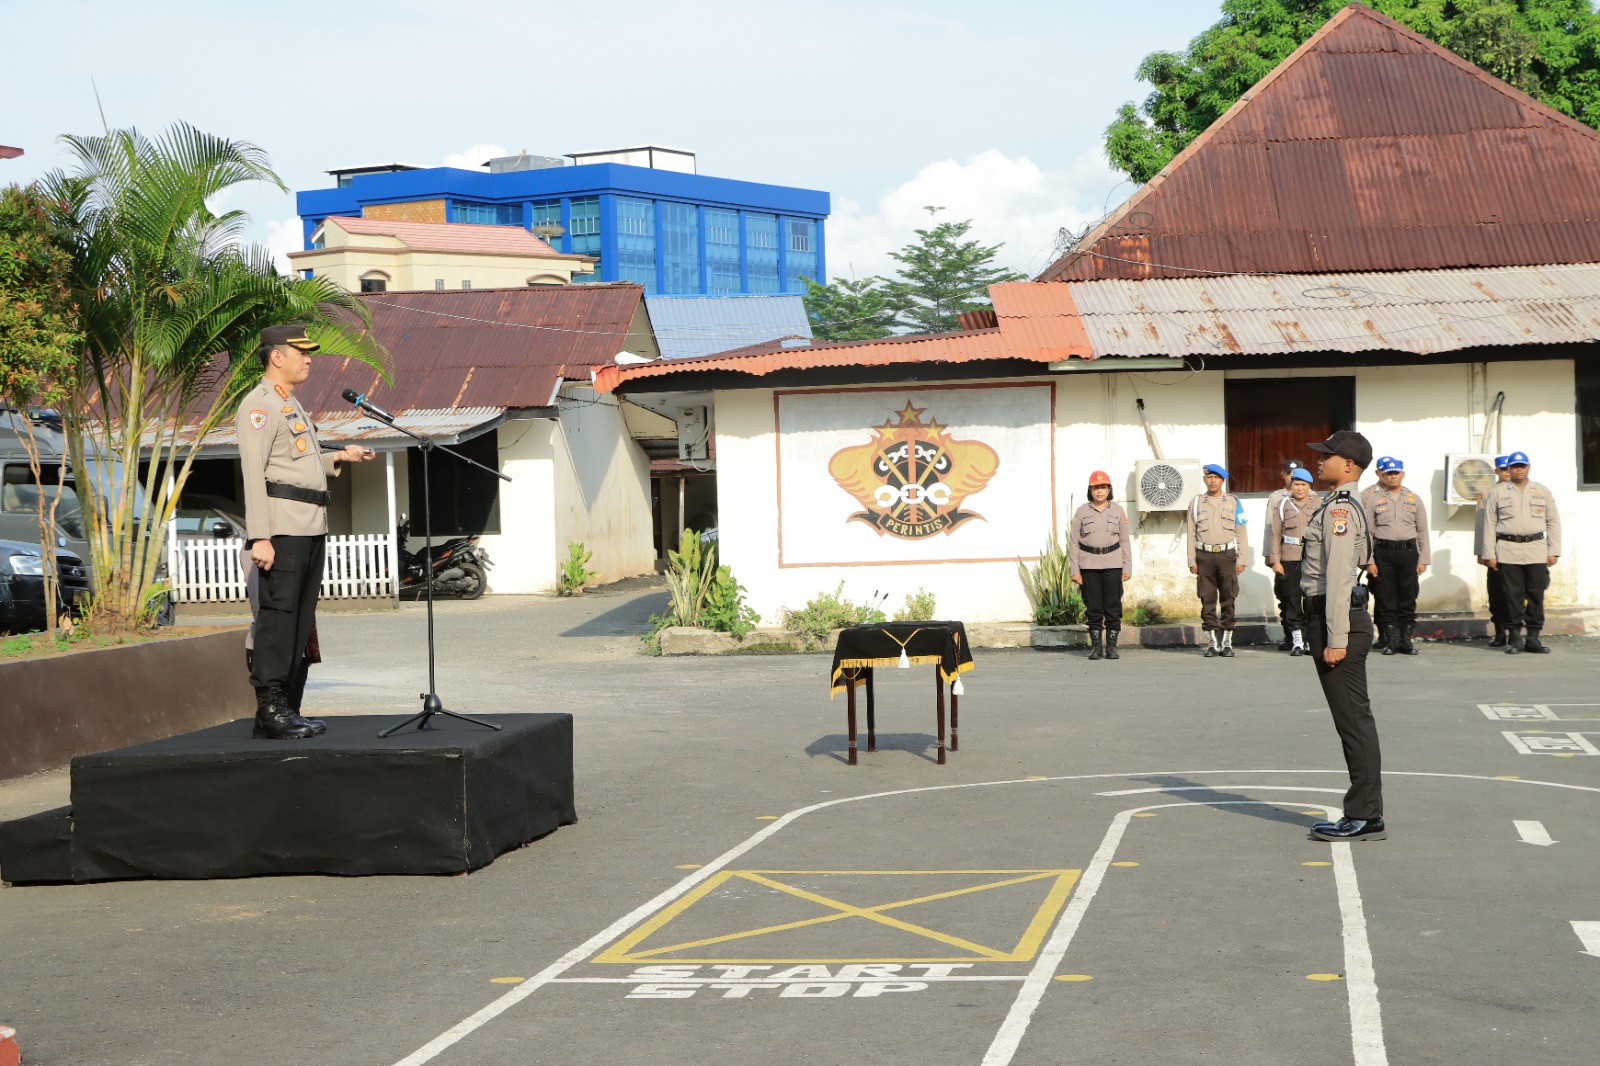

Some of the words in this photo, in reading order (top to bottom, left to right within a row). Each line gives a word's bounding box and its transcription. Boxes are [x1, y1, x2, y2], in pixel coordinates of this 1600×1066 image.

[885, 518, 943, 536] PERINTIS
[625, 963, 975, 979] START
[624, 981, 930, 999] STOP
